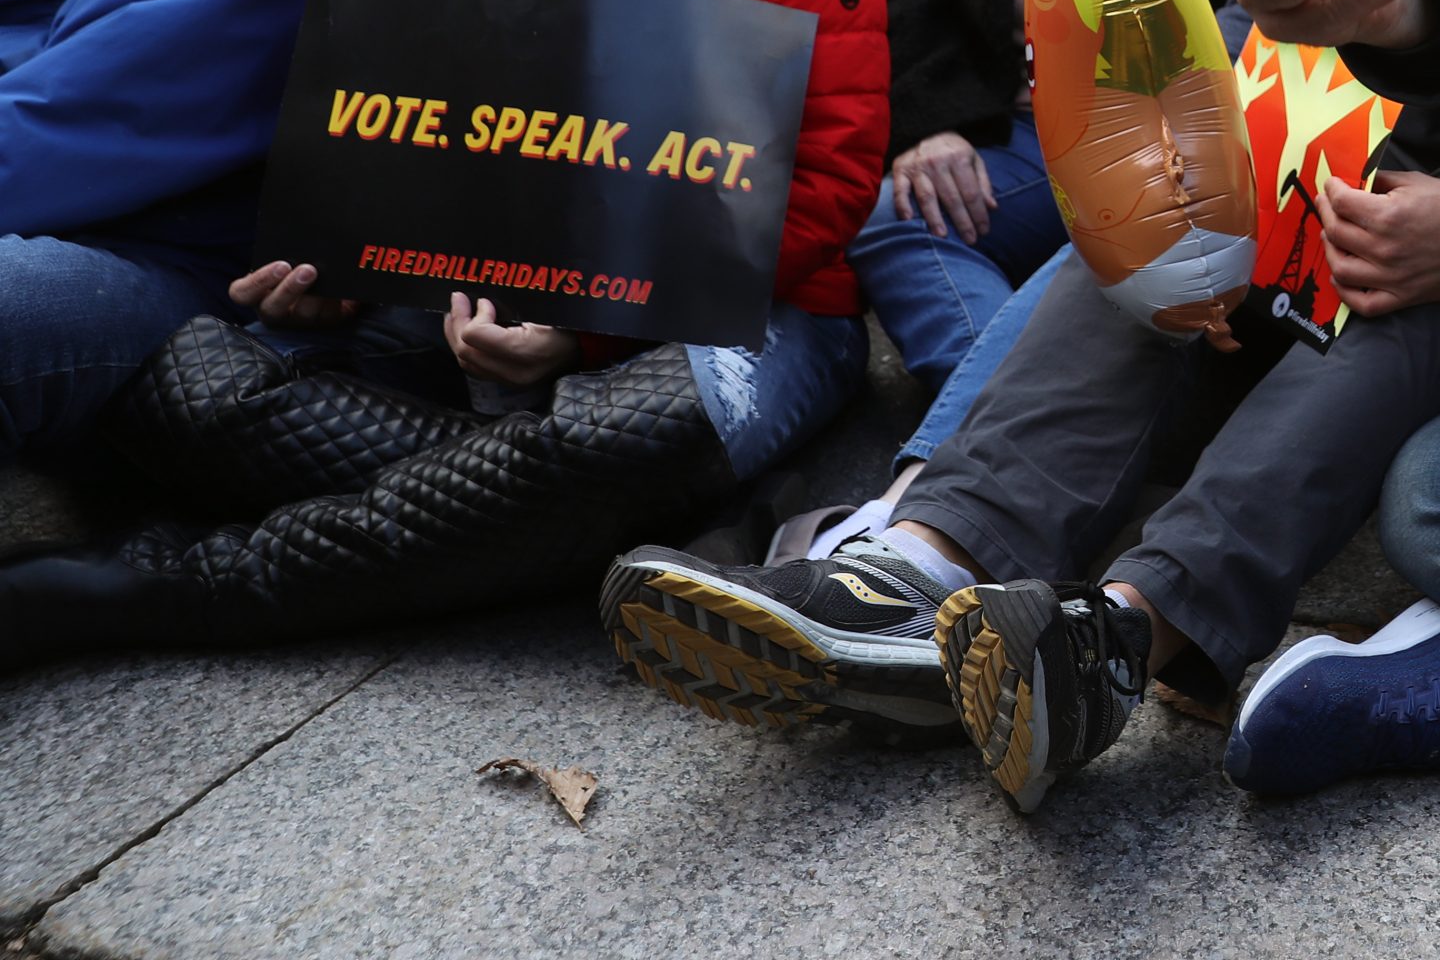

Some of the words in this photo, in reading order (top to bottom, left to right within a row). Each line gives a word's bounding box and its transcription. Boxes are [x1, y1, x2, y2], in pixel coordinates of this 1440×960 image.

[328, 89, 449, 149] VOTE.
[464, 104, 632, 171] SPEAK.
[645, 130, 756, 192] ACT.
[358, 244, 654, 306] FIREDRILLFRIDAYS.COM
